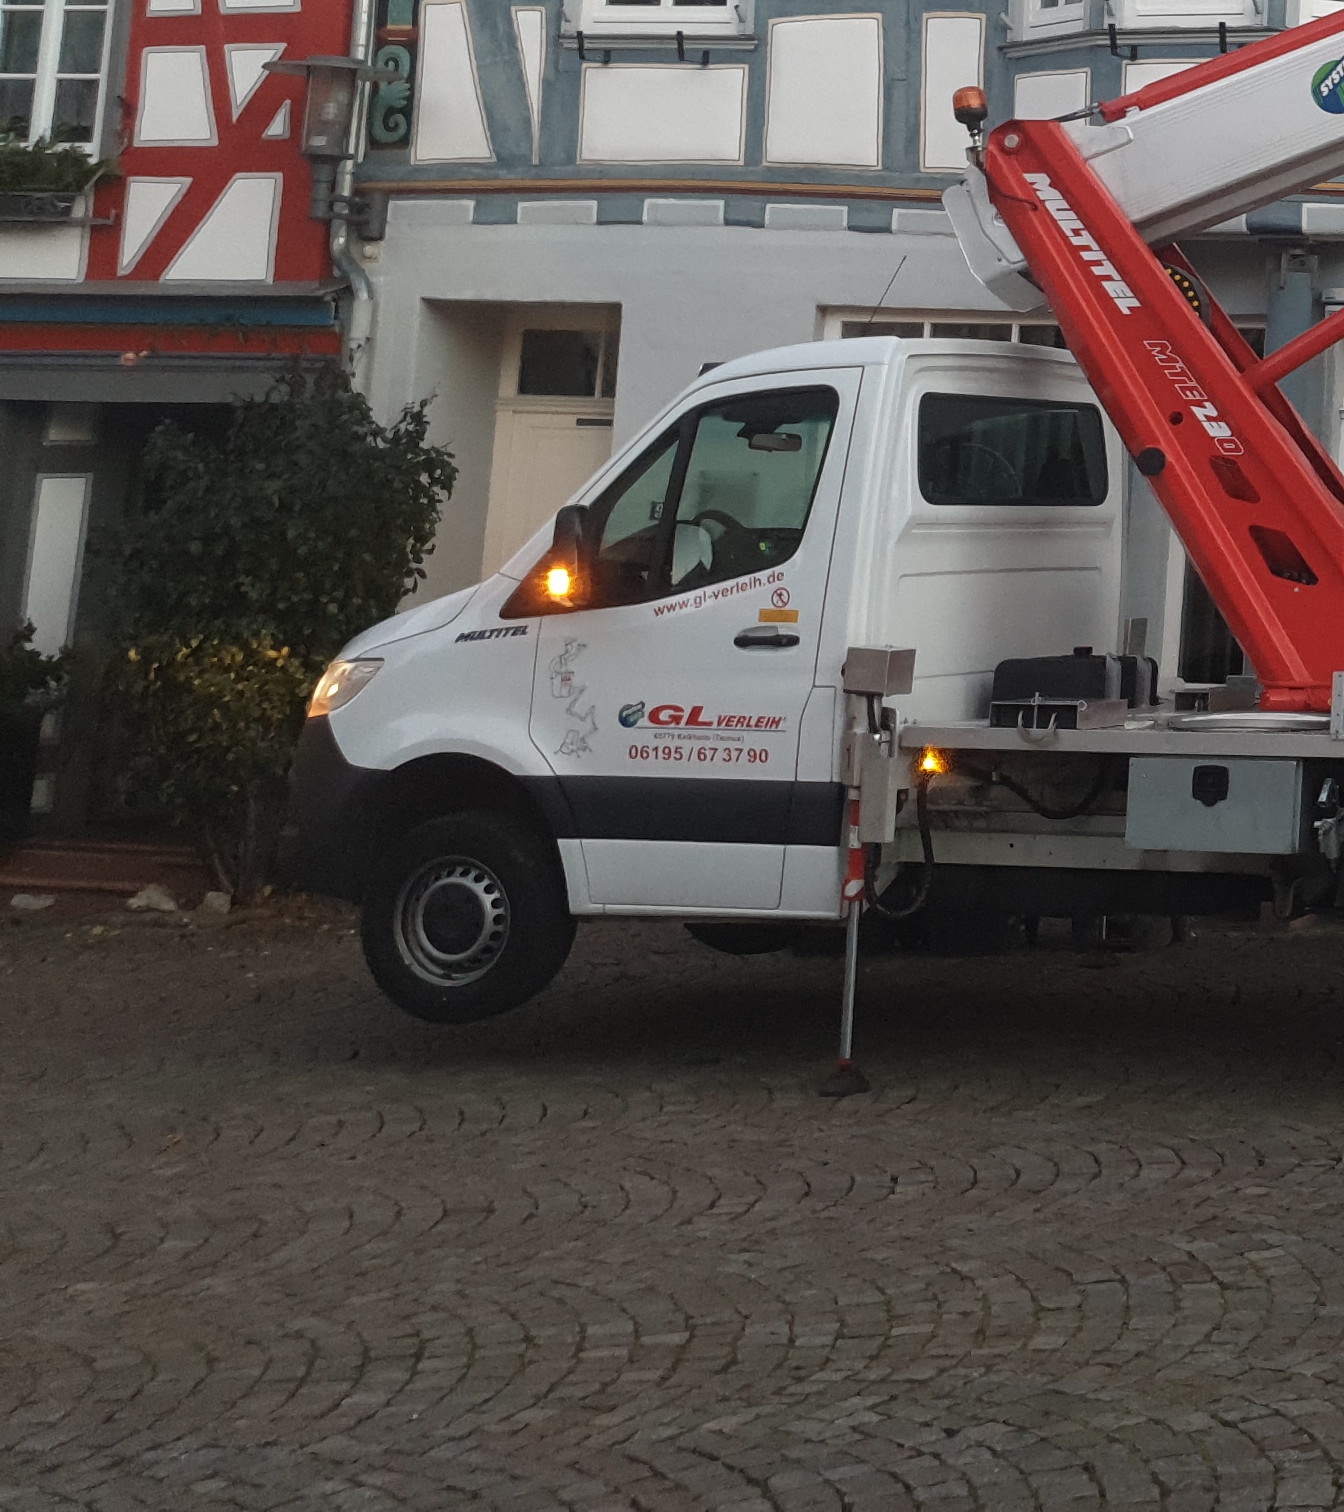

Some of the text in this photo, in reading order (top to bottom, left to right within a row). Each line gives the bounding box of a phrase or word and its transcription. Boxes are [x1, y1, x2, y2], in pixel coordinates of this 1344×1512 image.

[1023, 172, 1142, 315] MULTITEL
[652, 569, 785, 618] www.gl-verleih.de
[454, 624, 529, 643] MULTITEL
[647, 704, 714, 727] GL
[628, 744, 684, 761] 06195
[697, 747, 718, 762] 67
[722, 747, 744, 763] 37
[747, 748, 769, 764] 90
